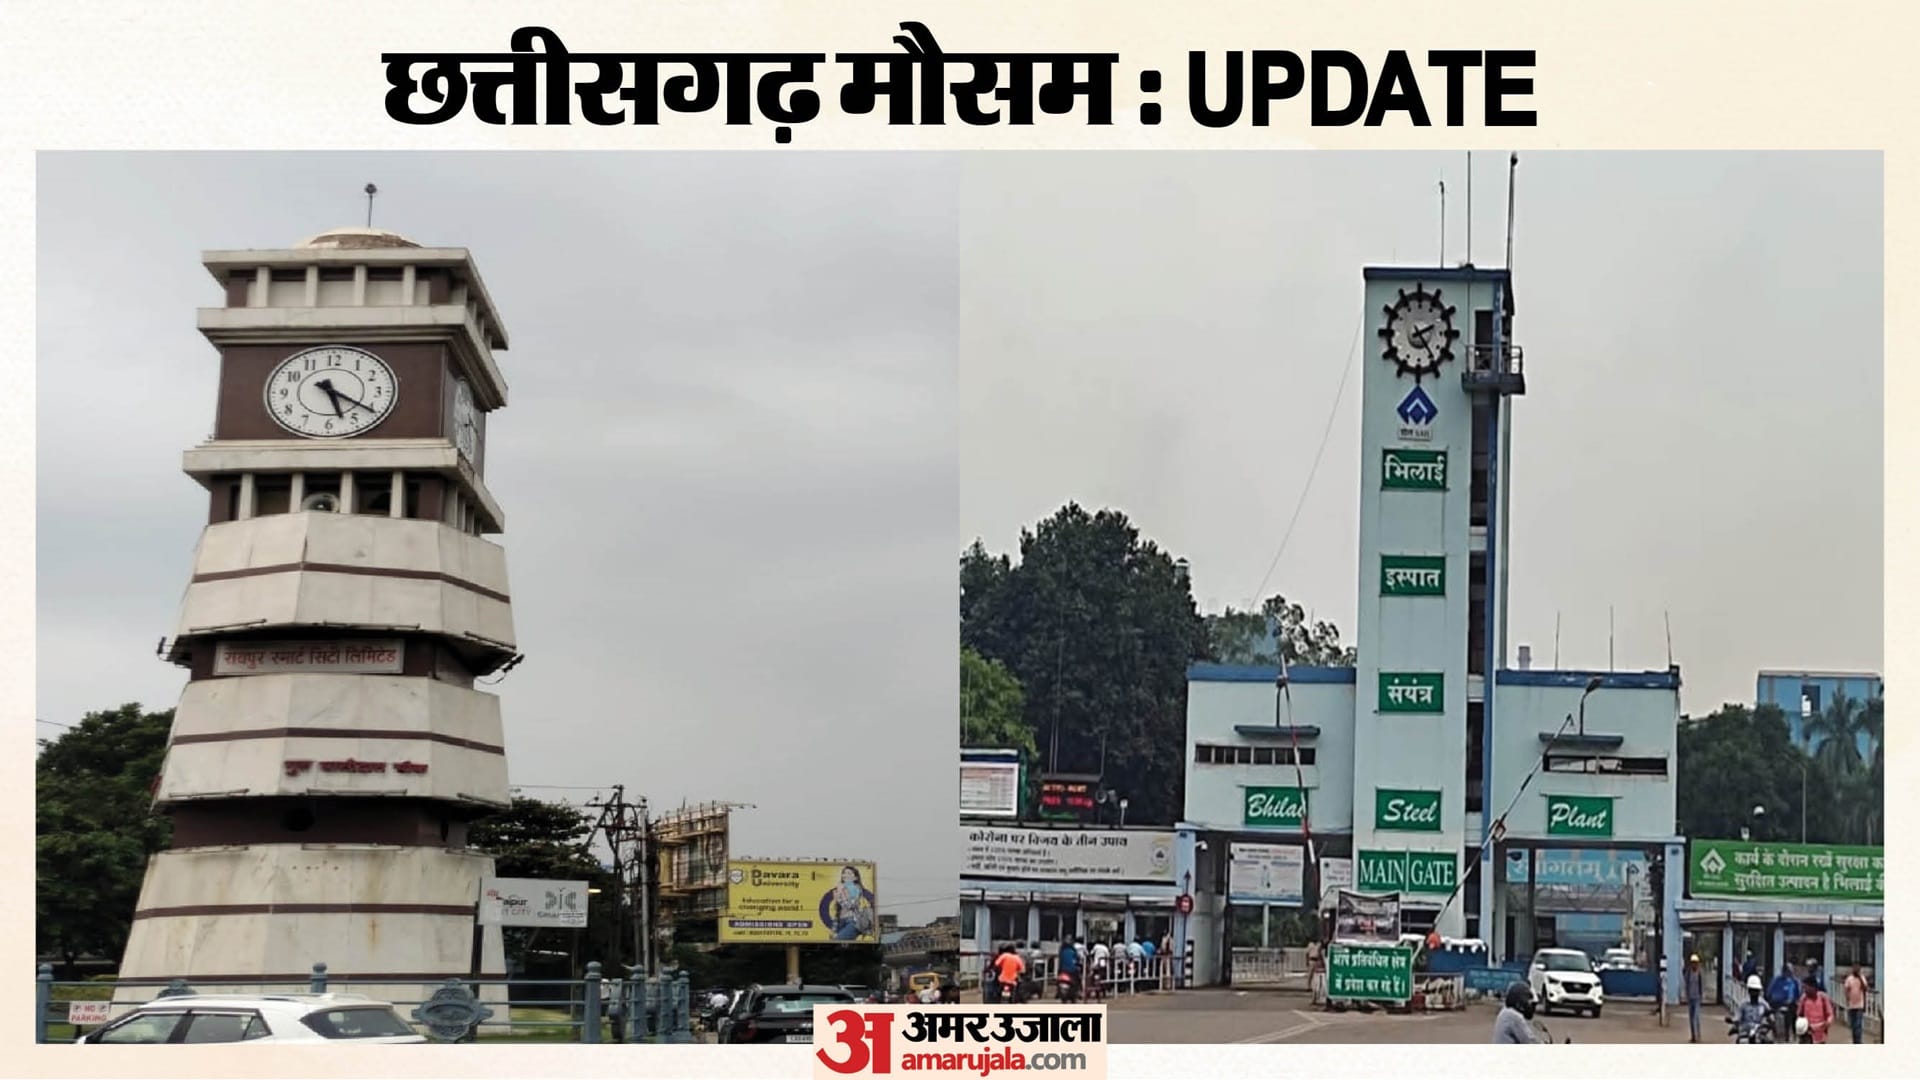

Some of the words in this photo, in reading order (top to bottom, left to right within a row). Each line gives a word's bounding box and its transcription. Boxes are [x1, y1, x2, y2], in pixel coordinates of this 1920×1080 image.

[304, 360, 316, 371] 11
[328, 355, 341, 366] 12
[356, 360, 360, 371] 1
[288, 371, 300, 382] 10
[368, 370, 376, 381] 2
[280, 388, 288, 398] 9
[374, 386, 382, 398] 3
[284, 404, 293, 415] 8
[301, 415, 309, 427] 7
[325, 419, 333, 430] 6
[350, 413, 359, 425] 5
[1385, 454, 1444, 485] भिलाई
[1385, 568, 1441, 590] इस्पात
[1382, 799, 1438, 822] Steel
[1550, 803, 1607, 829] Plant
[969, 831, 1008, 843] कोरोना
[1010, 833, 1025, 845] पर
[1360, 859, 1405, 885] MAIN
[1411, 860, 1454, 886] GATE
